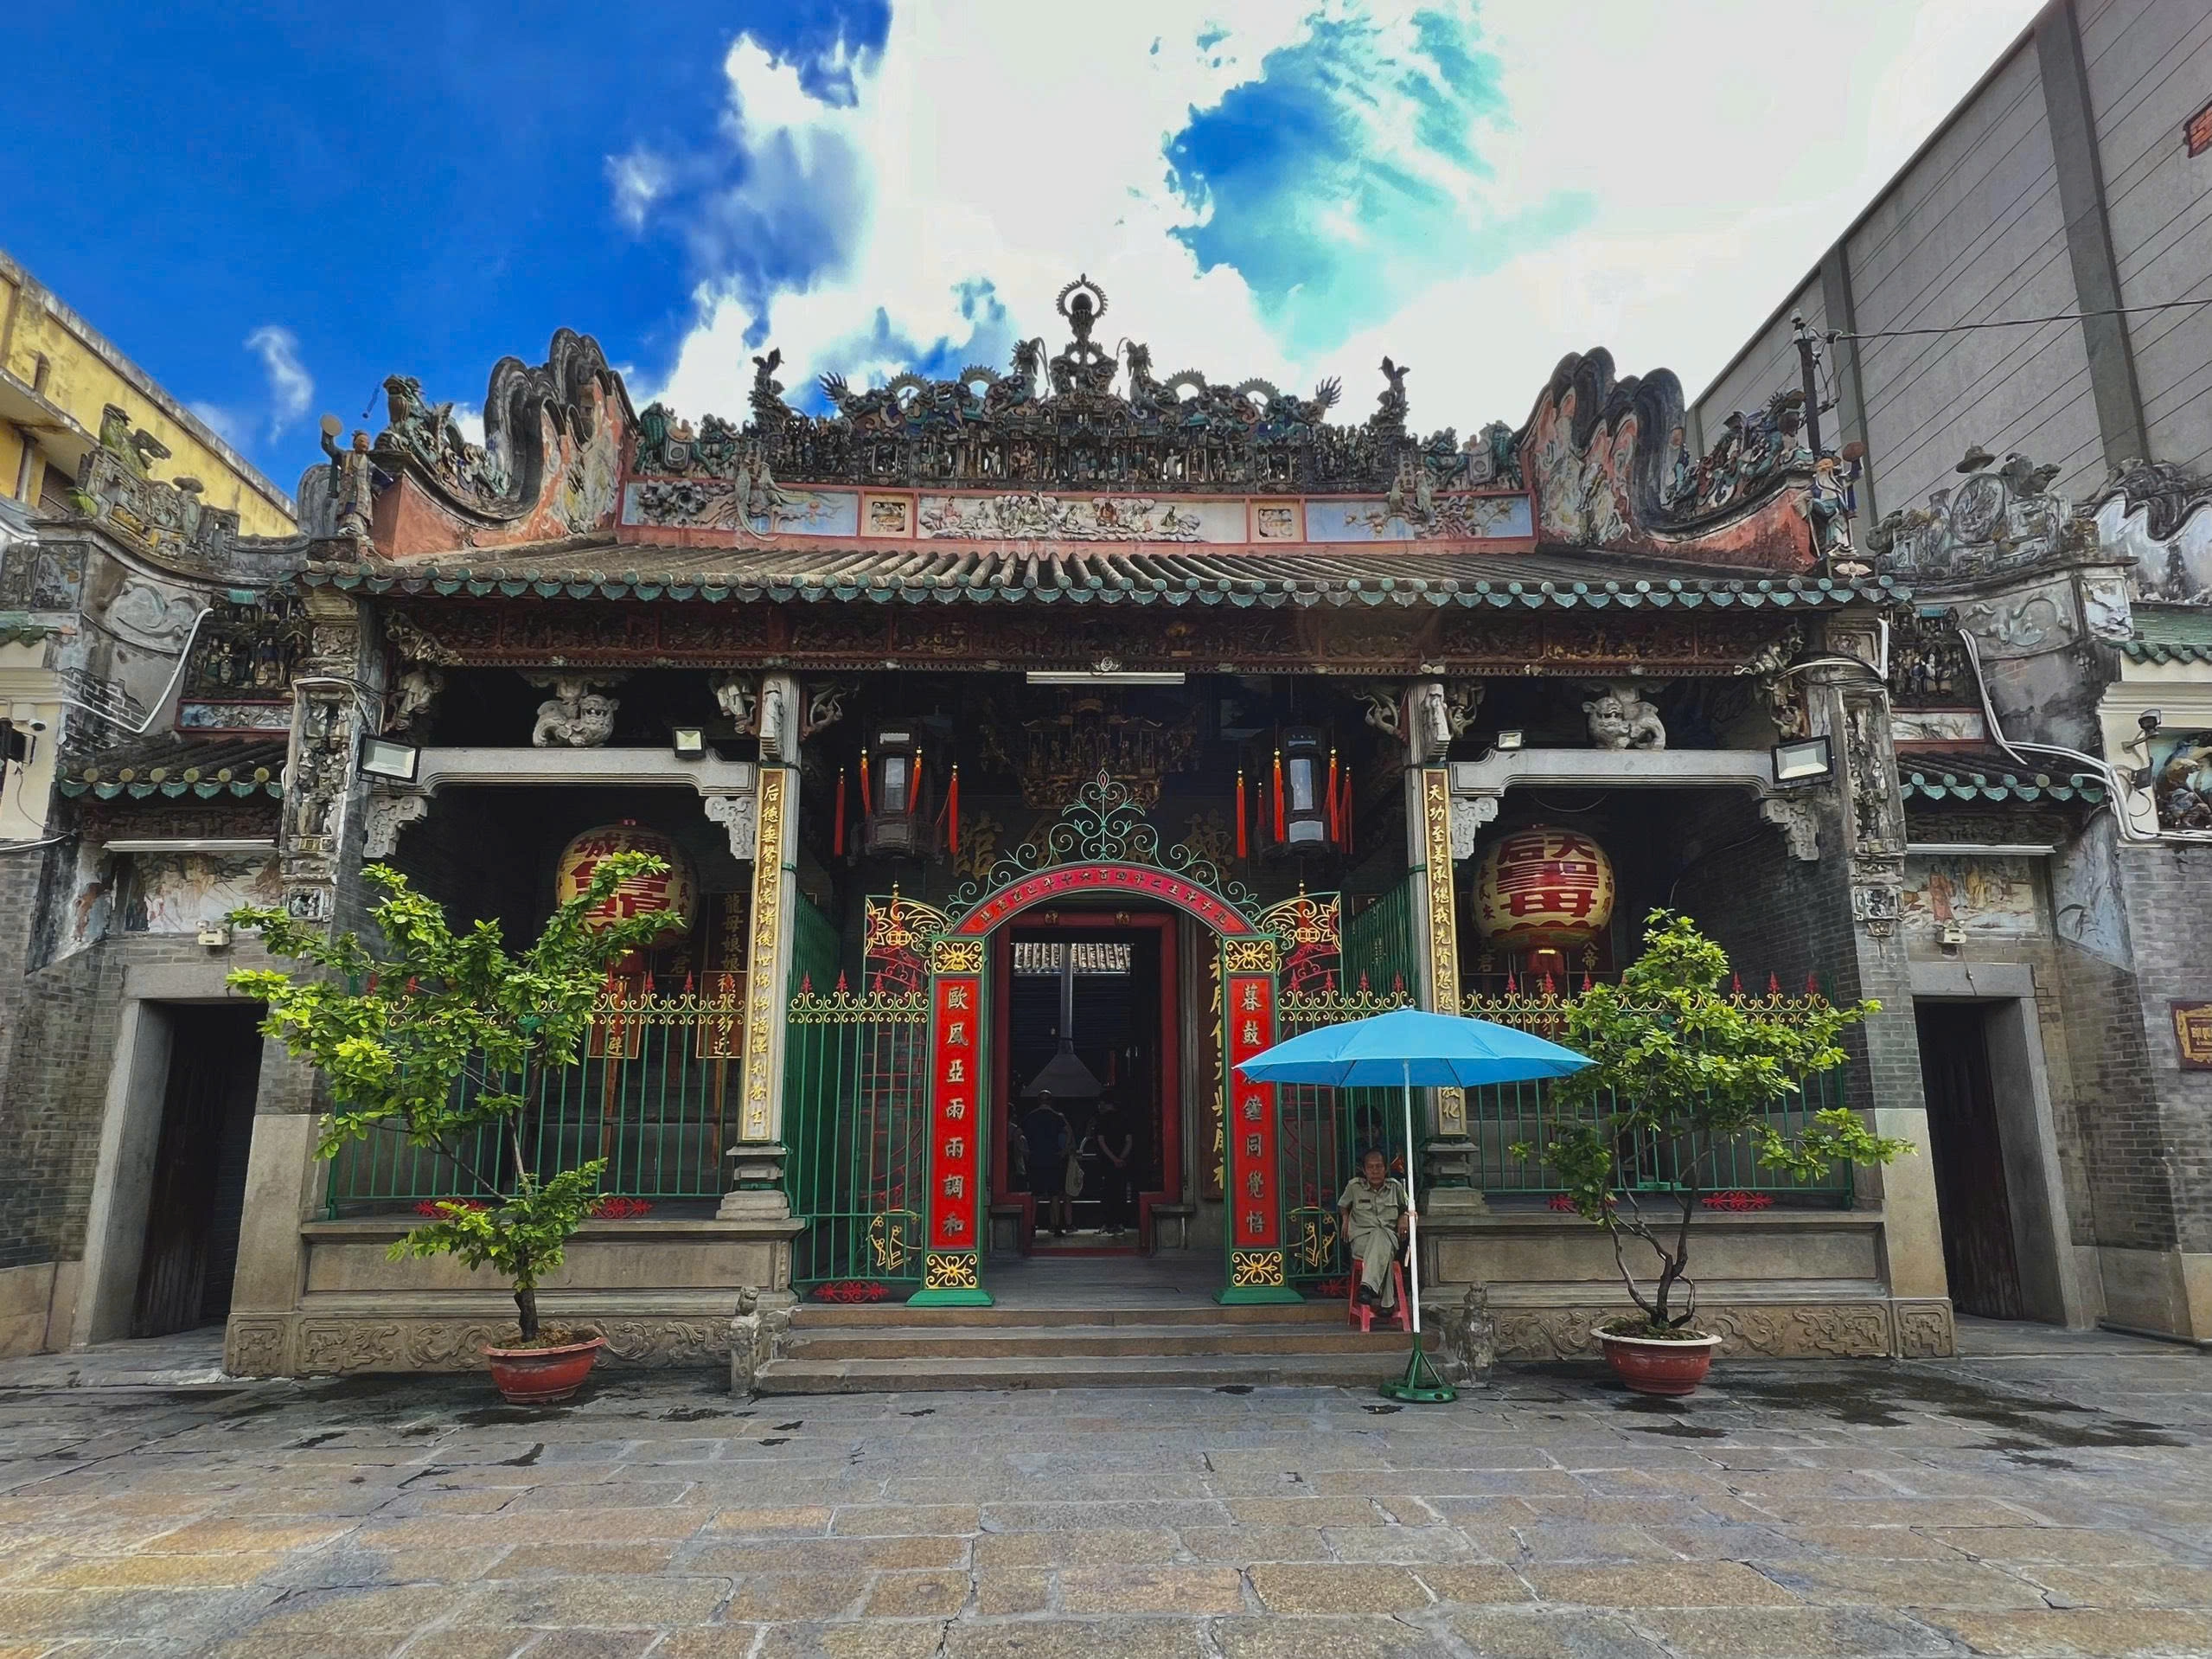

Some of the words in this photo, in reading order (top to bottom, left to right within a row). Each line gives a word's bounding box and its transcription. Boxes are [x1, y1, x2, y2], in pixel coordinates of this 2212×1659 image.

[1240, 983, 1266, 1234] 暮鼓鐘同覺悟
